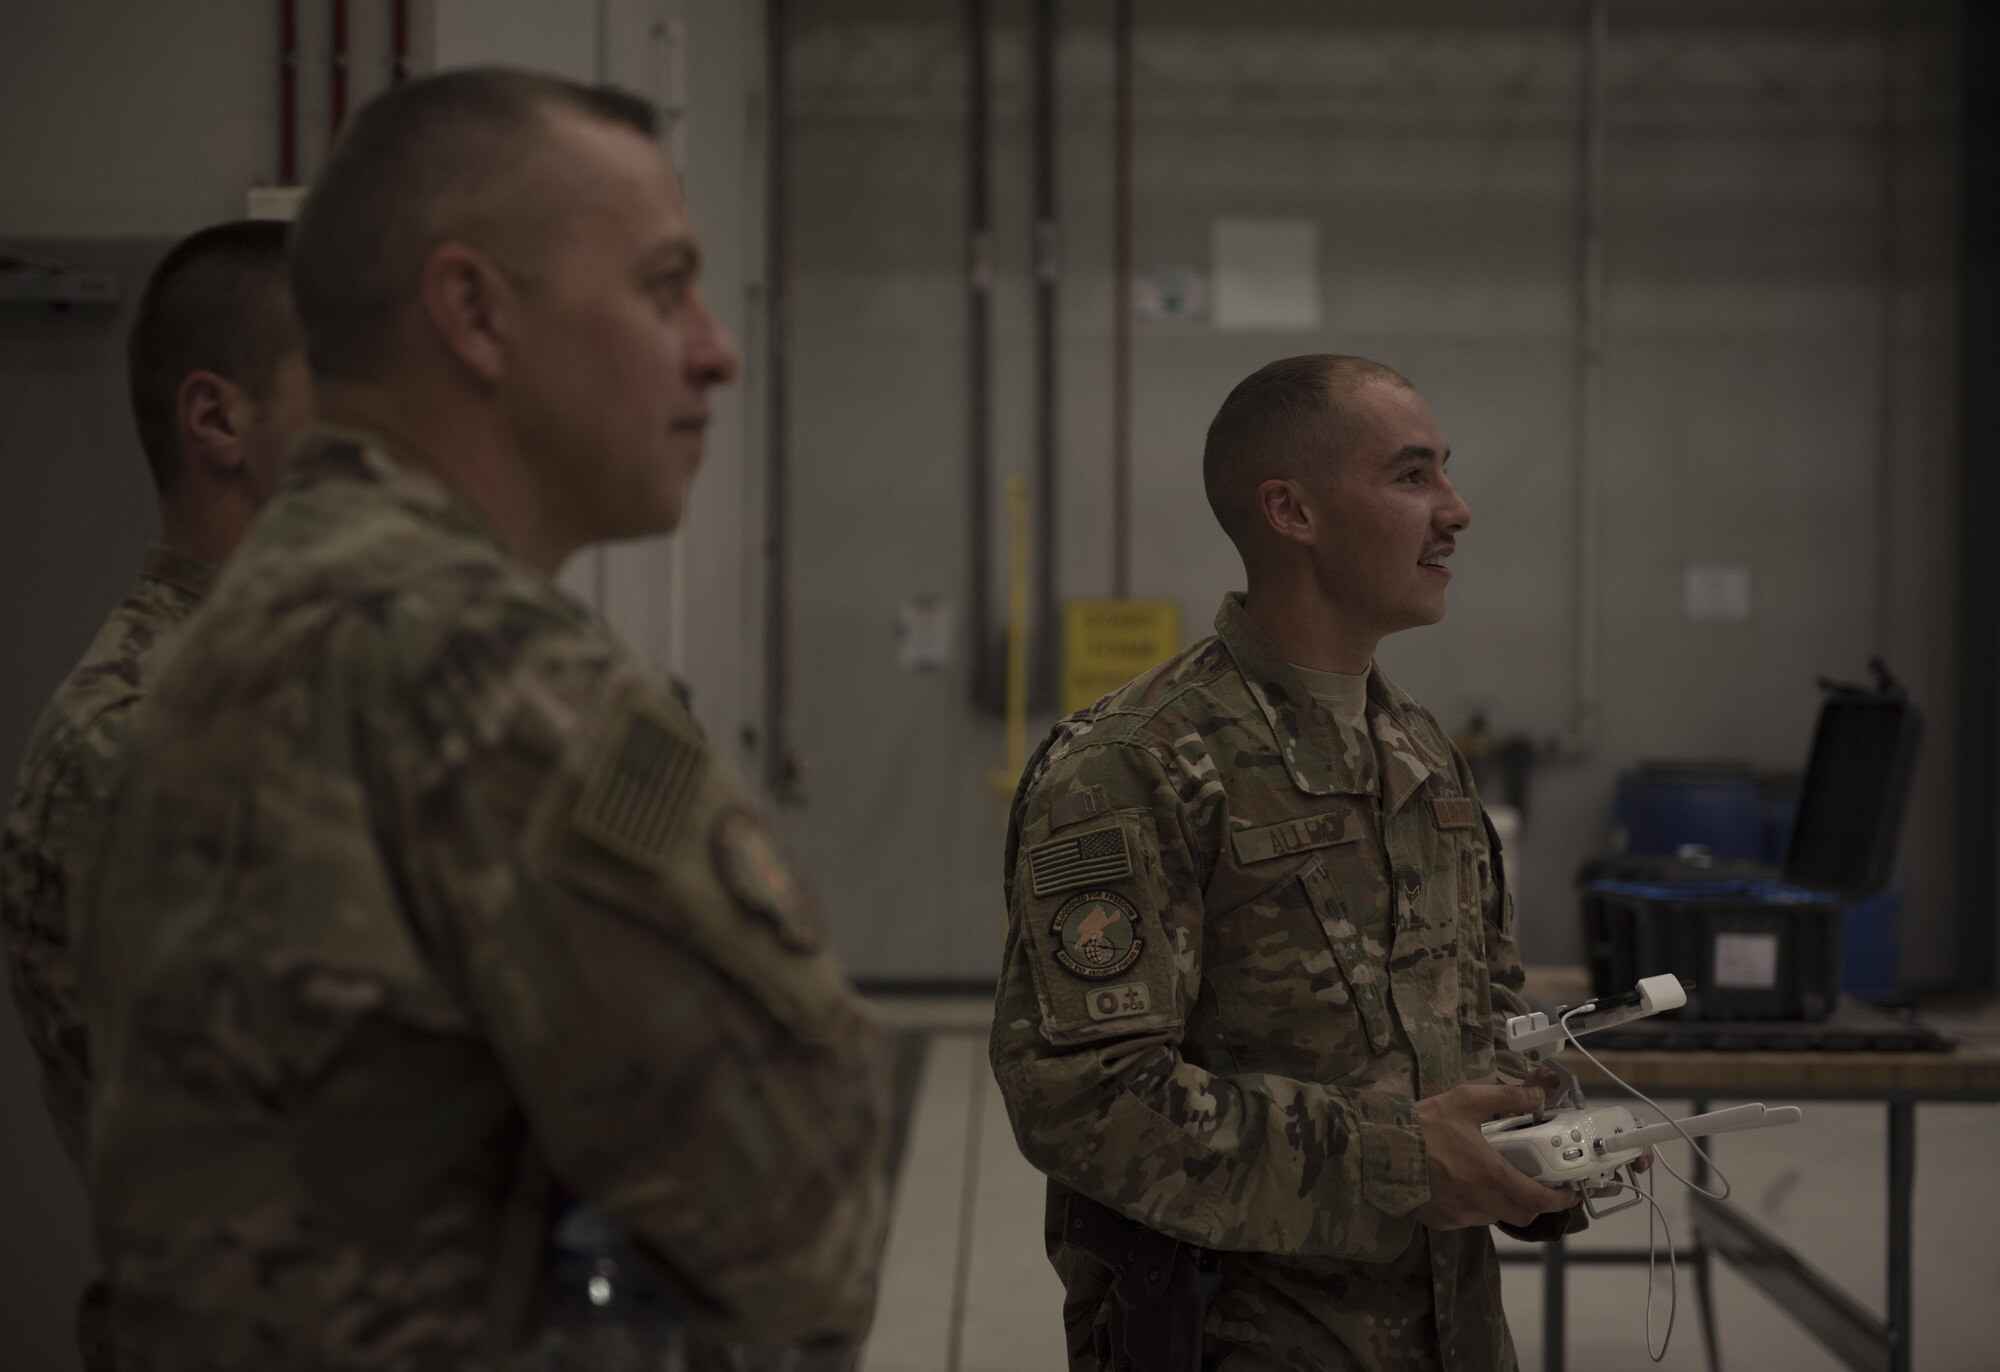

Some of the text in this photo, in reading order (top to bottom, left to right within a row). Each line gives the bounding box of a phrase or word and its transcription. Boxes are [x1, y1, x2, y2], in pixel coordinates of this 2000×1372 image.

[1104, 893, 1135, 917] FREEDOM
[1096, 991, 1119, 1015] O
[1122, 1000, 1145, 1012] POS
